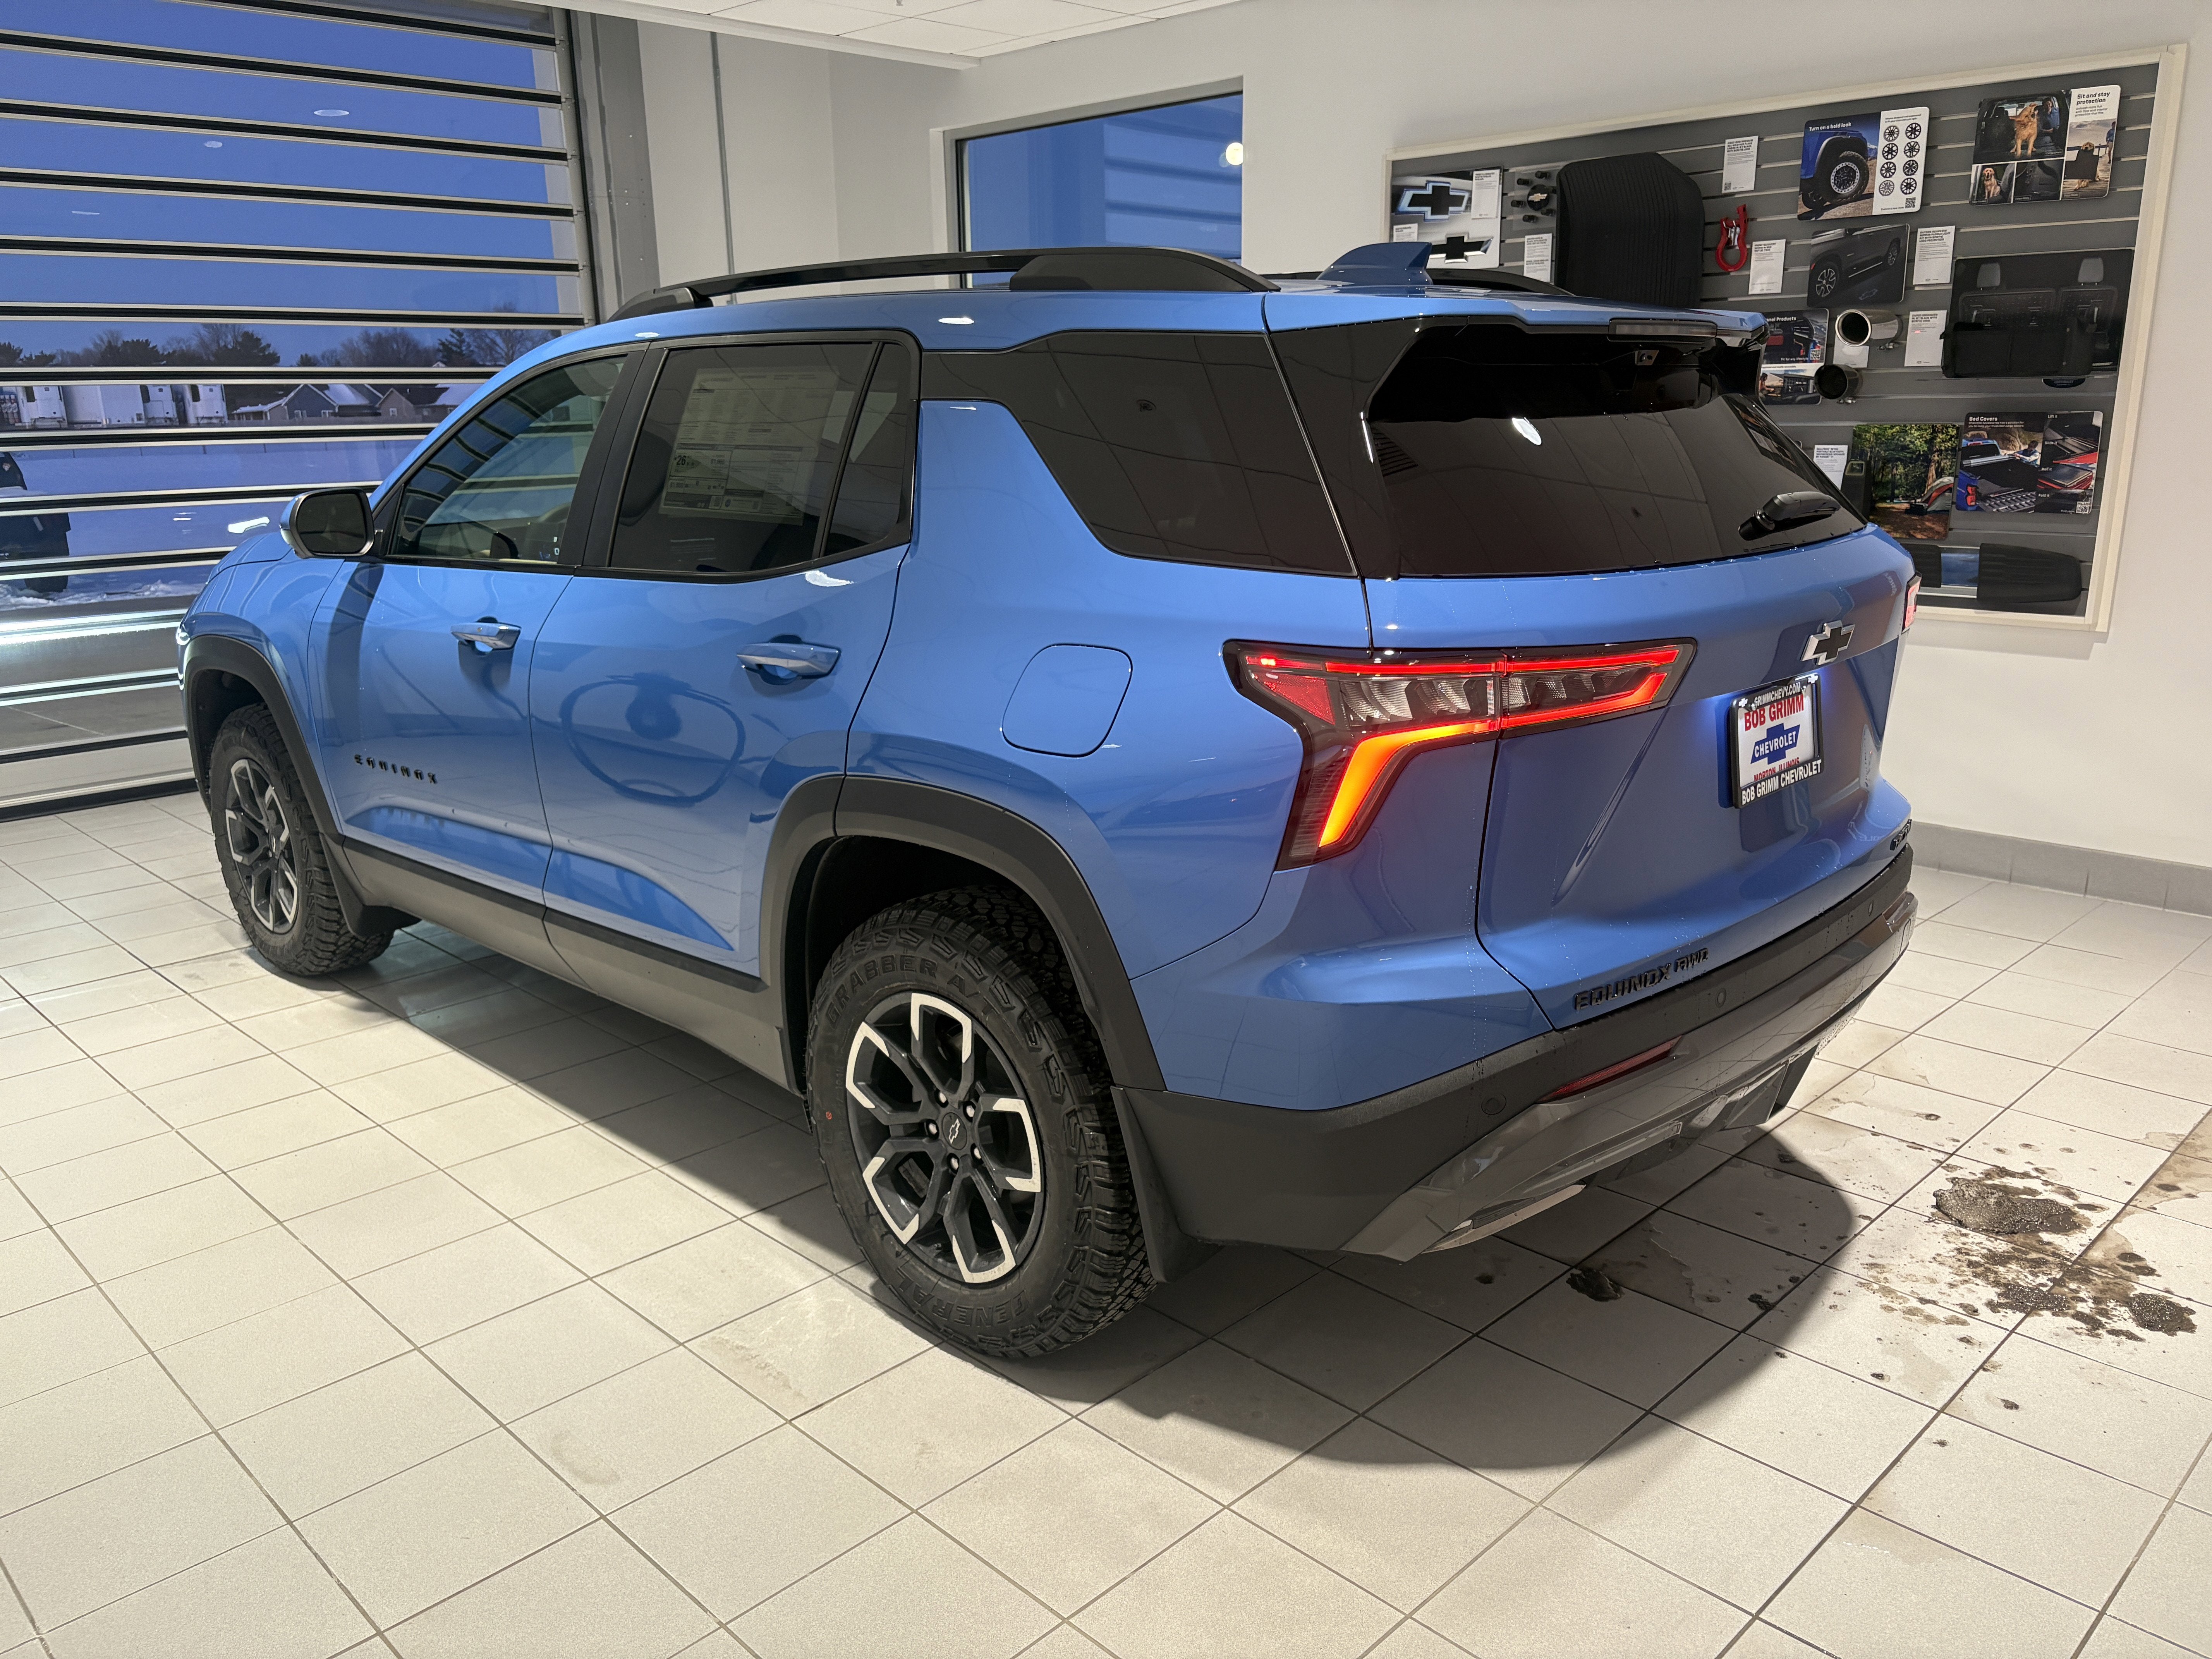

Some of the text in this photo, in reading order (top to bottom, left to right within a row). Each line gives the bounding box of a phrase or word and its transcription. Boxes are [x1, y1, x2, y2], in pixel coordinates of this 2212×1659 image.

[677, 455, 686, 465] 26
[1745, 694, 1804, 731] BOB GRIMM
[1754, 682, 1801, 707] GRIMMCHEVY.COM
[1754, 731, 1796, 757] CHEVROLET
[354, 754, 438, 784] EQUINOX
[1742, 759, 1821, 805] BOB GRIMM CHEVROLET
[826, 954, 937, 1029] GRABBER
[1574, 948, 1709, 1010] EQUINOX AWD
[896, 1266, 1029, 1328] GENERAL
